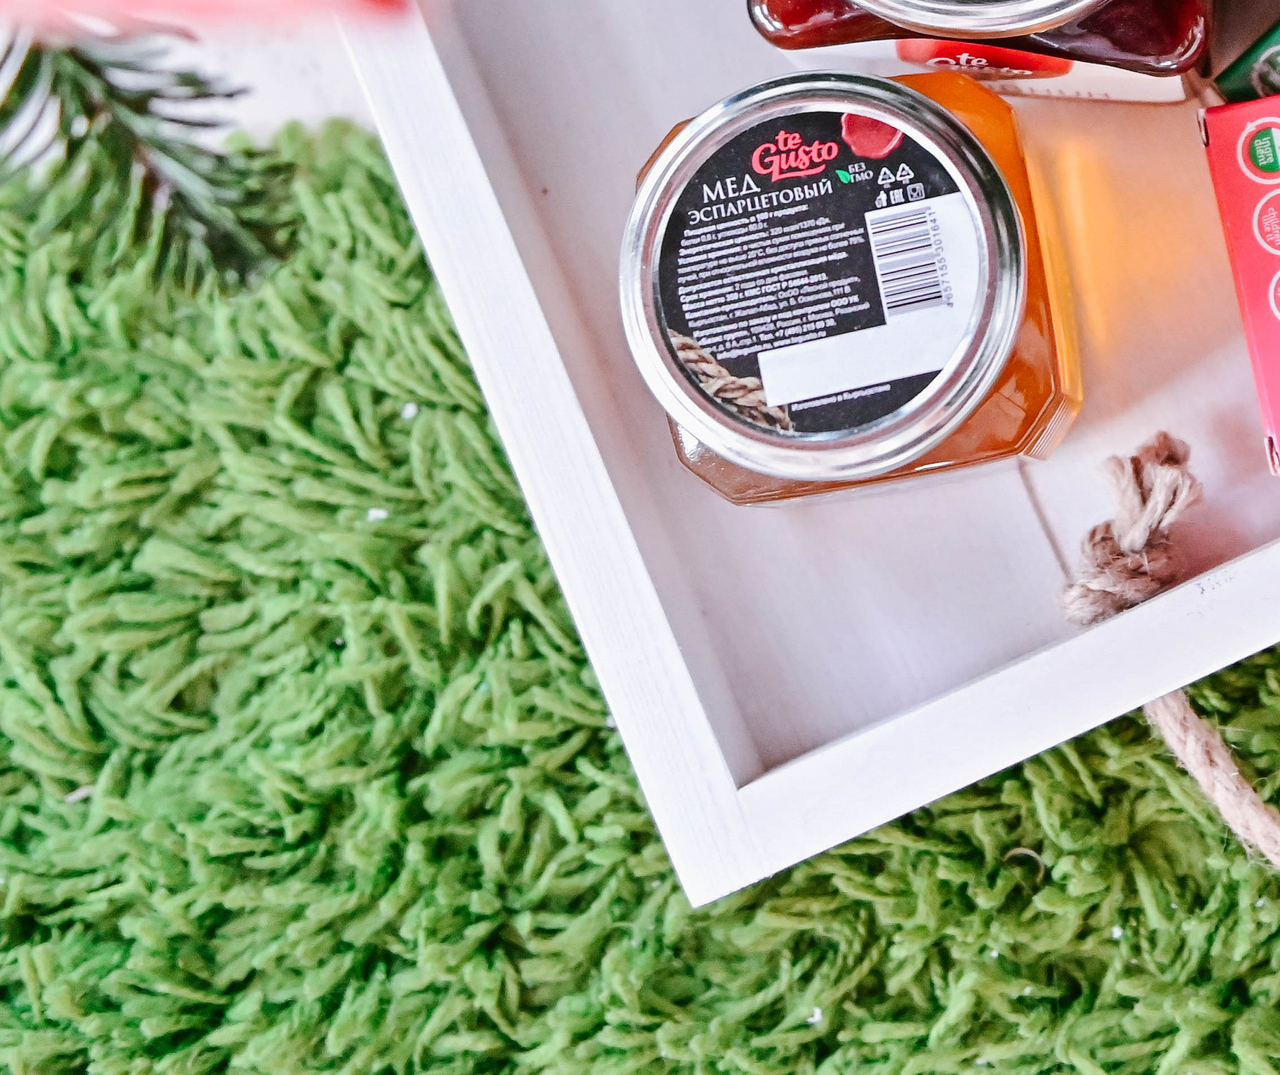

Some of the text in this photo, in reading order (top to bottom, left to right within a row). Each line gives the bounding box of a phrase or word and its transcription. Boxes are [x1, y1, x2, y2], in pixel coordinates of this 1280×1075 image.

[776, 130, 802, 151] te
[751, 140, 840, 182] Gusto
[848, 162, 866, 174] БЕЗ
[850, 170, 874, 184] ГМО
[687, 178, 834, 225] ЭСПАРЦЕТОВЫЙ
[702, 177, 760, 204] МЕД
